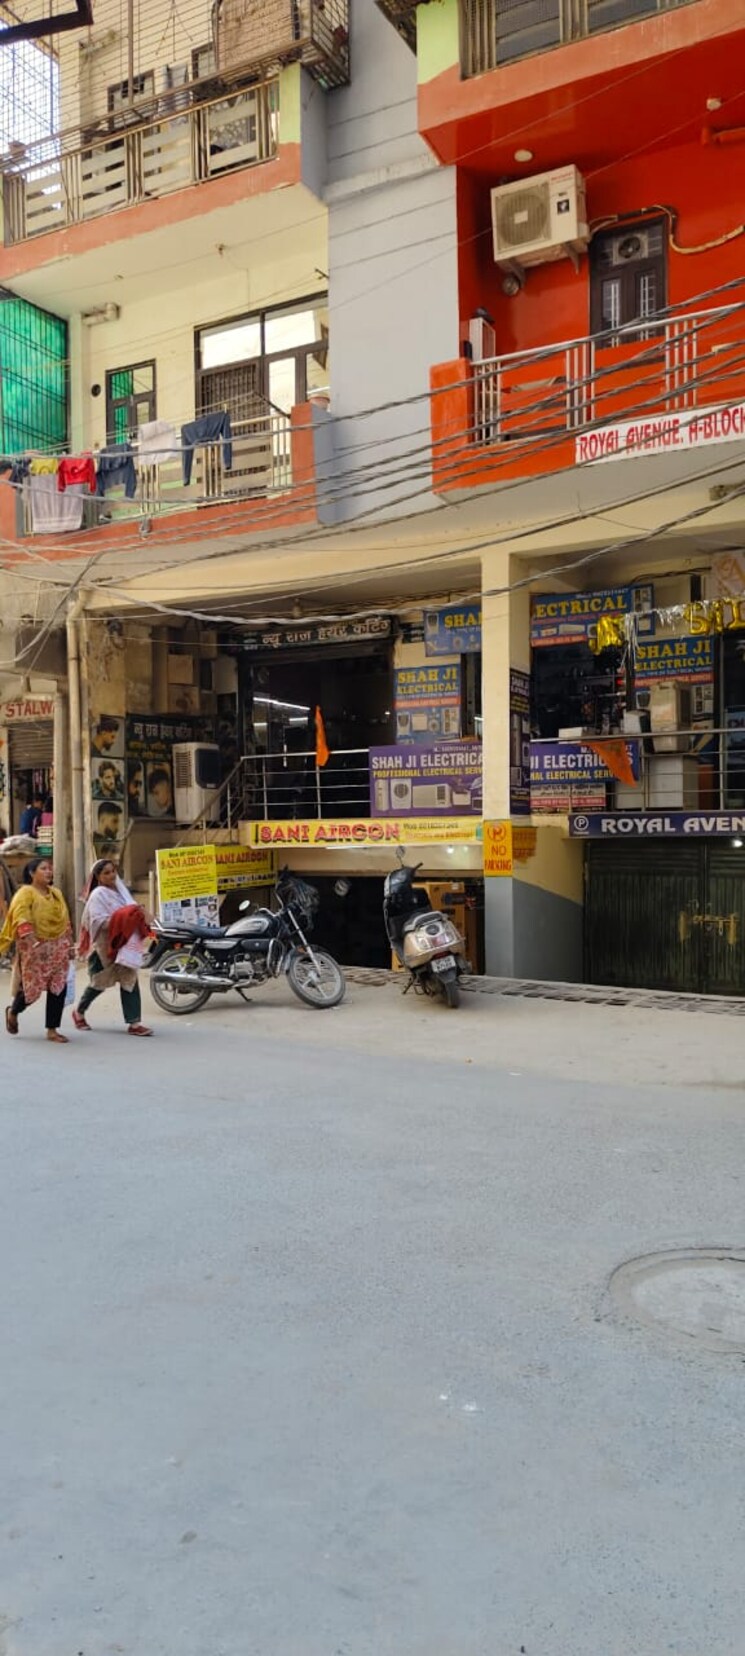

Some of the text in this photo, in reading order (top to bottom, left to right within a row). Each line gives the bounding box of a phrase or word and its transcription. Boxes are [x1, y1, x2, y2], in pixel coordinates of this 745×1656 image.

[579, 430, 620, 460] ROYAL
[534, 596, 627, 618] ECTRICAL
[637, 640, 711, 660] SHAH JI
[635, 656, 712, 672] ELECTRICAL
[398, 667, 457, 683] SHAH JI
[397, 682, 456, 694] ELECTRICAL
[5, 701, 54, 718] STALW
[372, 756, 403, 769] SHAH
[406, 755, 417, 767] JI
[545, 770, 592, 779] ELECTRICAL
[260, 822, 400, 843] SANI AIRCON
[600, 817, 676, 834] ROYAL
[491, 845, 506, 856] NO
